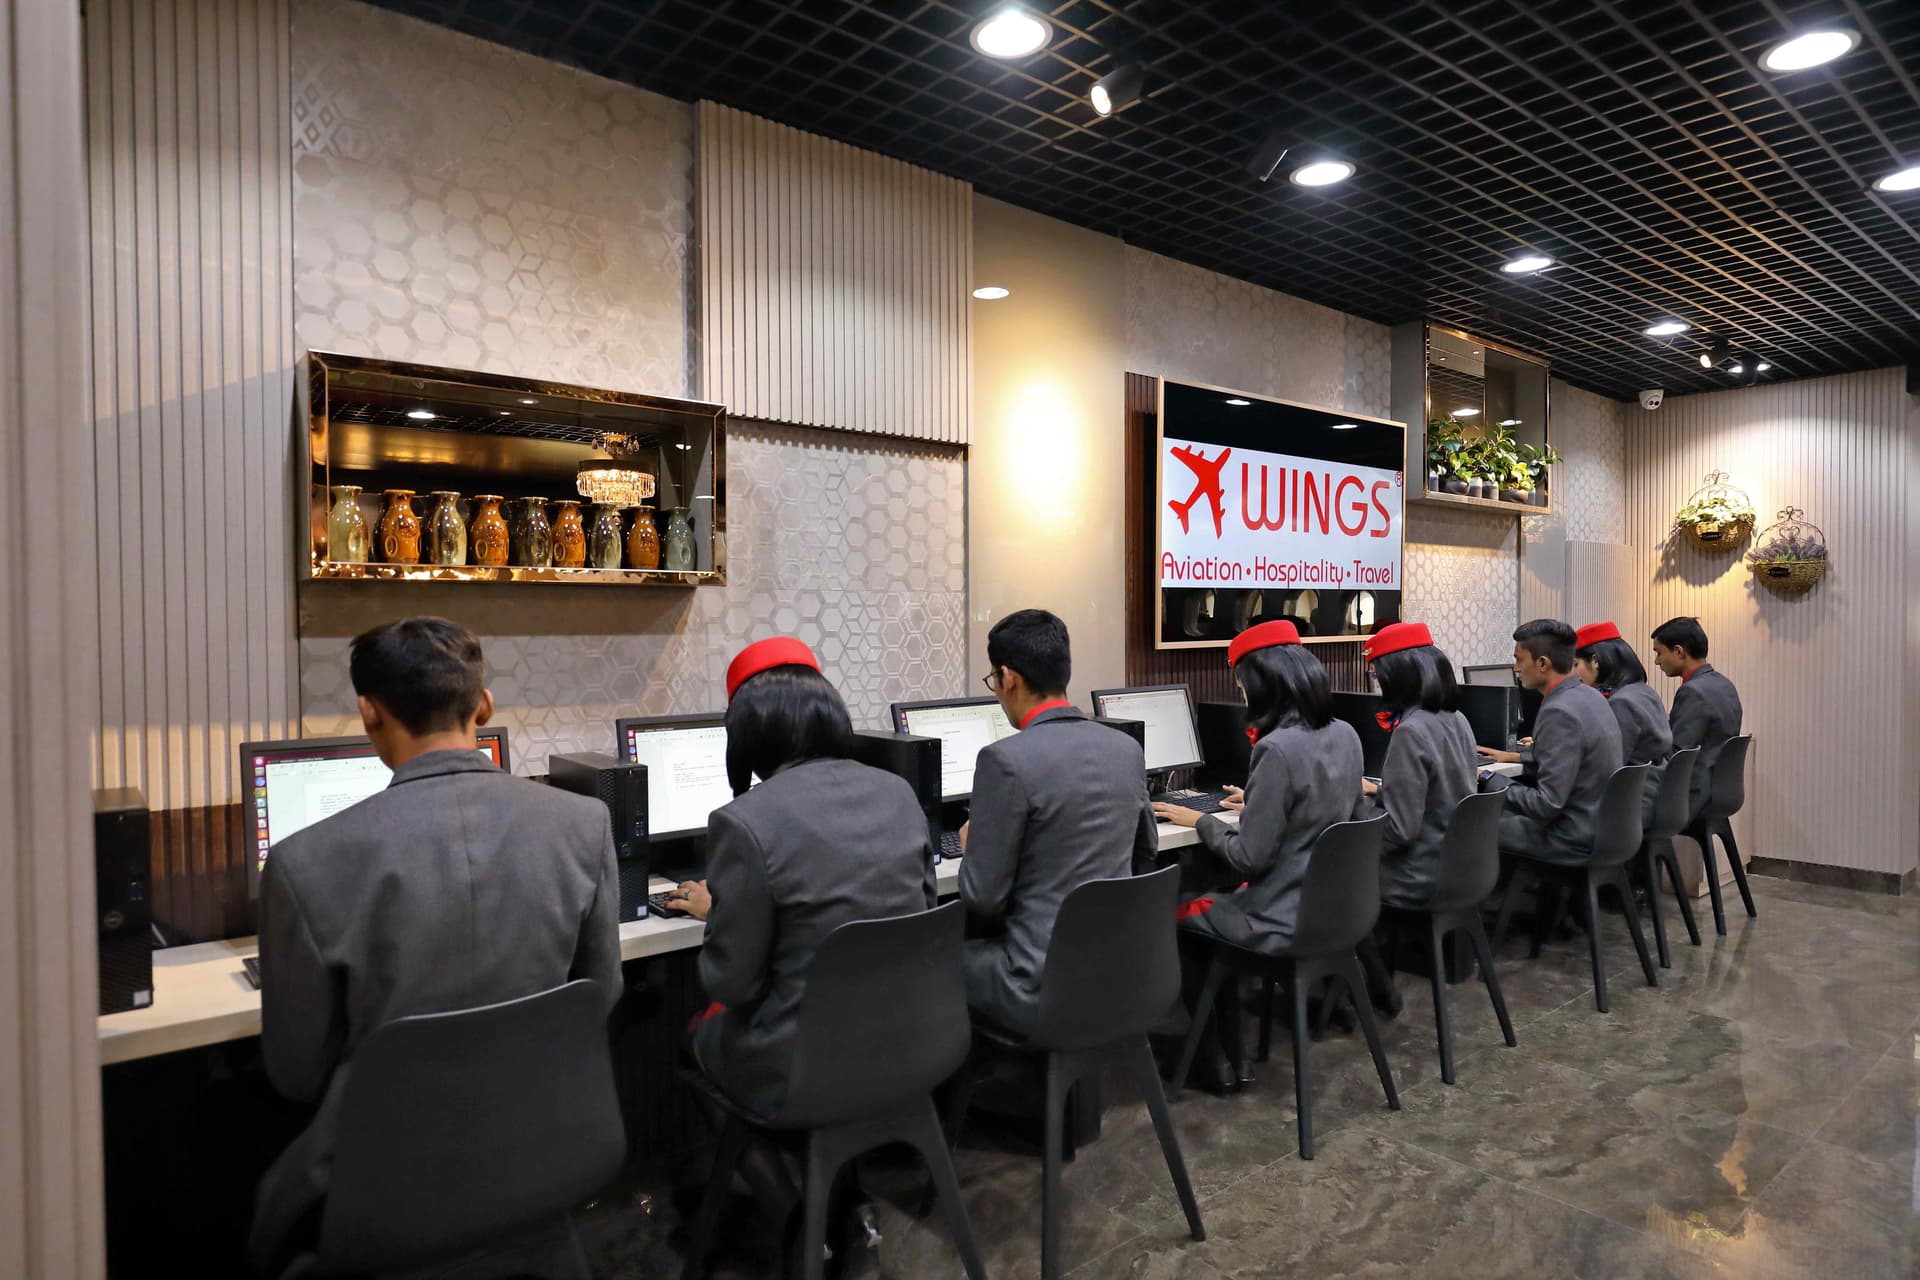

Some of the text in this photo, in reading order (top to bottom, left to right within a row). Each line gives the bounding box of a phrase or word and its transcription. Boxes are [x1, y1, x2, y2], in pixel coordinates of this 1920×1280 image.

[1242, 462, 1391, 538] WINGS
[1162, 552, 1394, 588] Aviation Hospitality Travel
